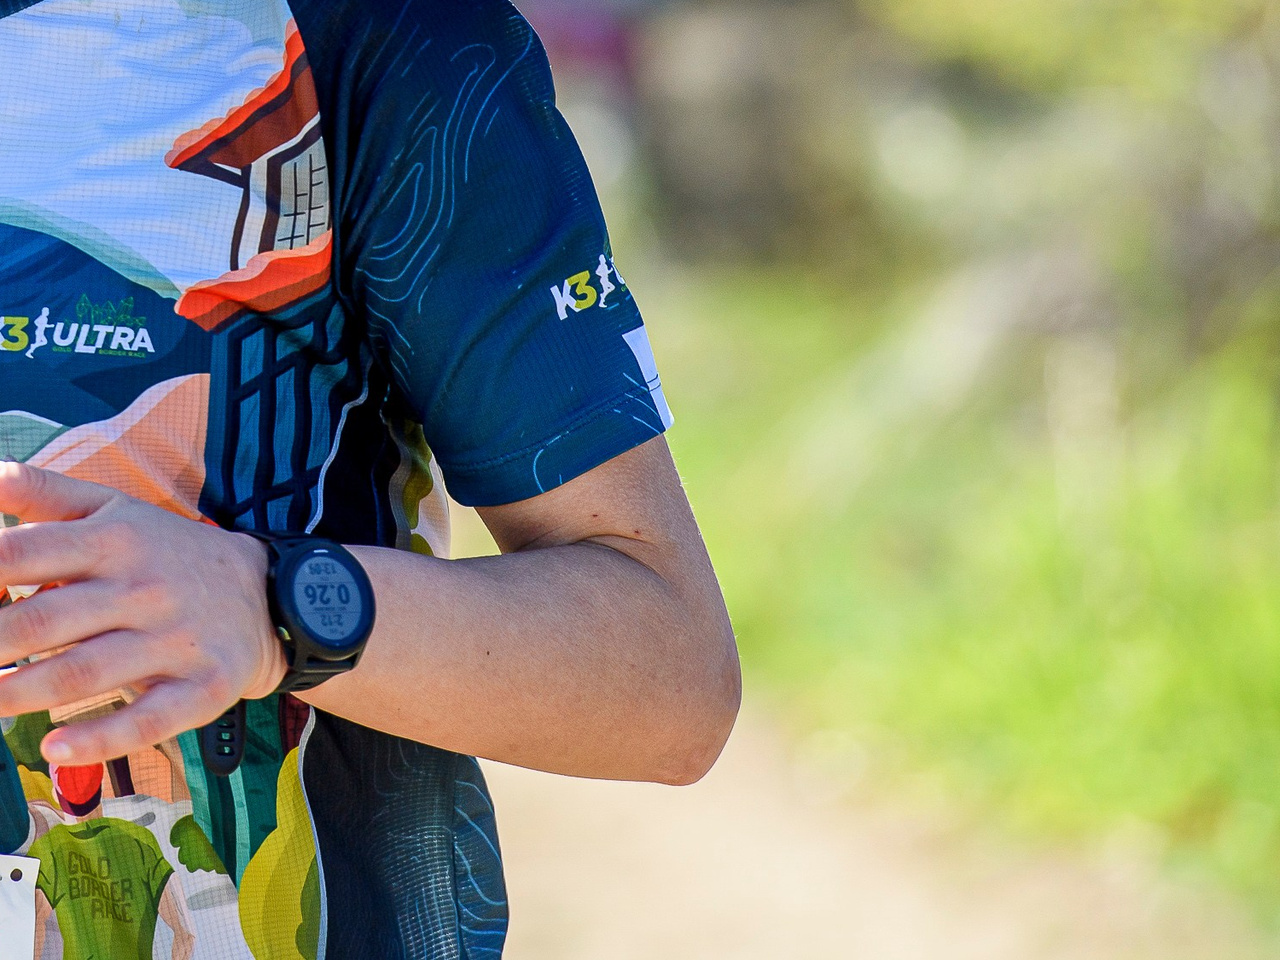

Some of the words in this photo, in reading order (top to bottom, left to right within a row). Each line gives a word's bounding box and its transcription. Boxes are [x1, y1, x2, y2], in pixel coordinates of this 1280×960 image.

[550, 270, 597, 320] K3
[53, 322, 156, 354] ULTRA
[303, 583, 351, 606] 0.26
[68, 851, 110, 880] GOLD
[69, 877, 134, 902] BORDER
[91, 898, 134, 924] RACE
